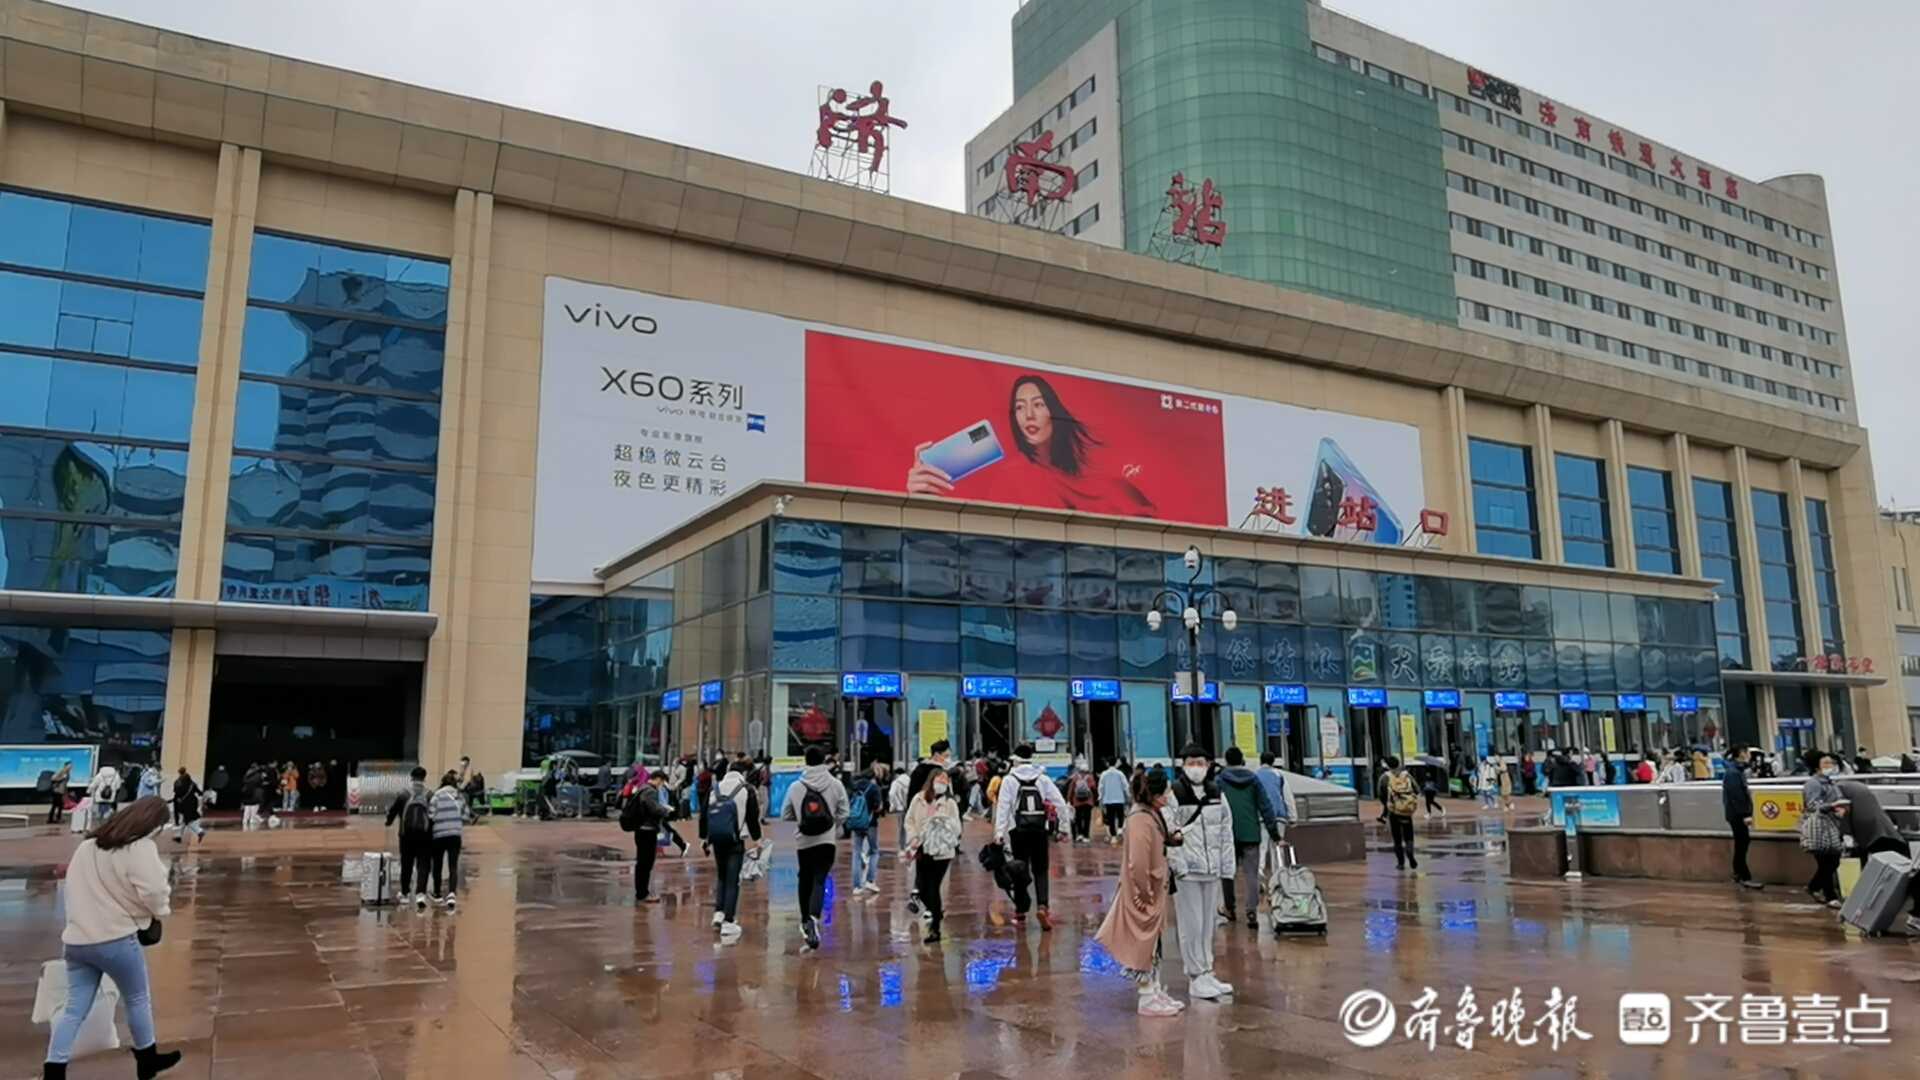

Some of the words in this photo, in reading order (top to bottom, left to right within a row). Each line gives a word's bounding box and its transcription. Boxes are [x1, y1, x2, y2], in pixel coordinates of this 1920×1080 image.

[564, 303, 658, 334] vivo
[601, 367, 744, 410] X60系列
[656, 405, 684, 416] vivo
[614, 444, 727, 472] 超稳微云台
[614, 470, 728, 497] 夜色更精彩
[1254, 486, 1448, 537] 进站口
